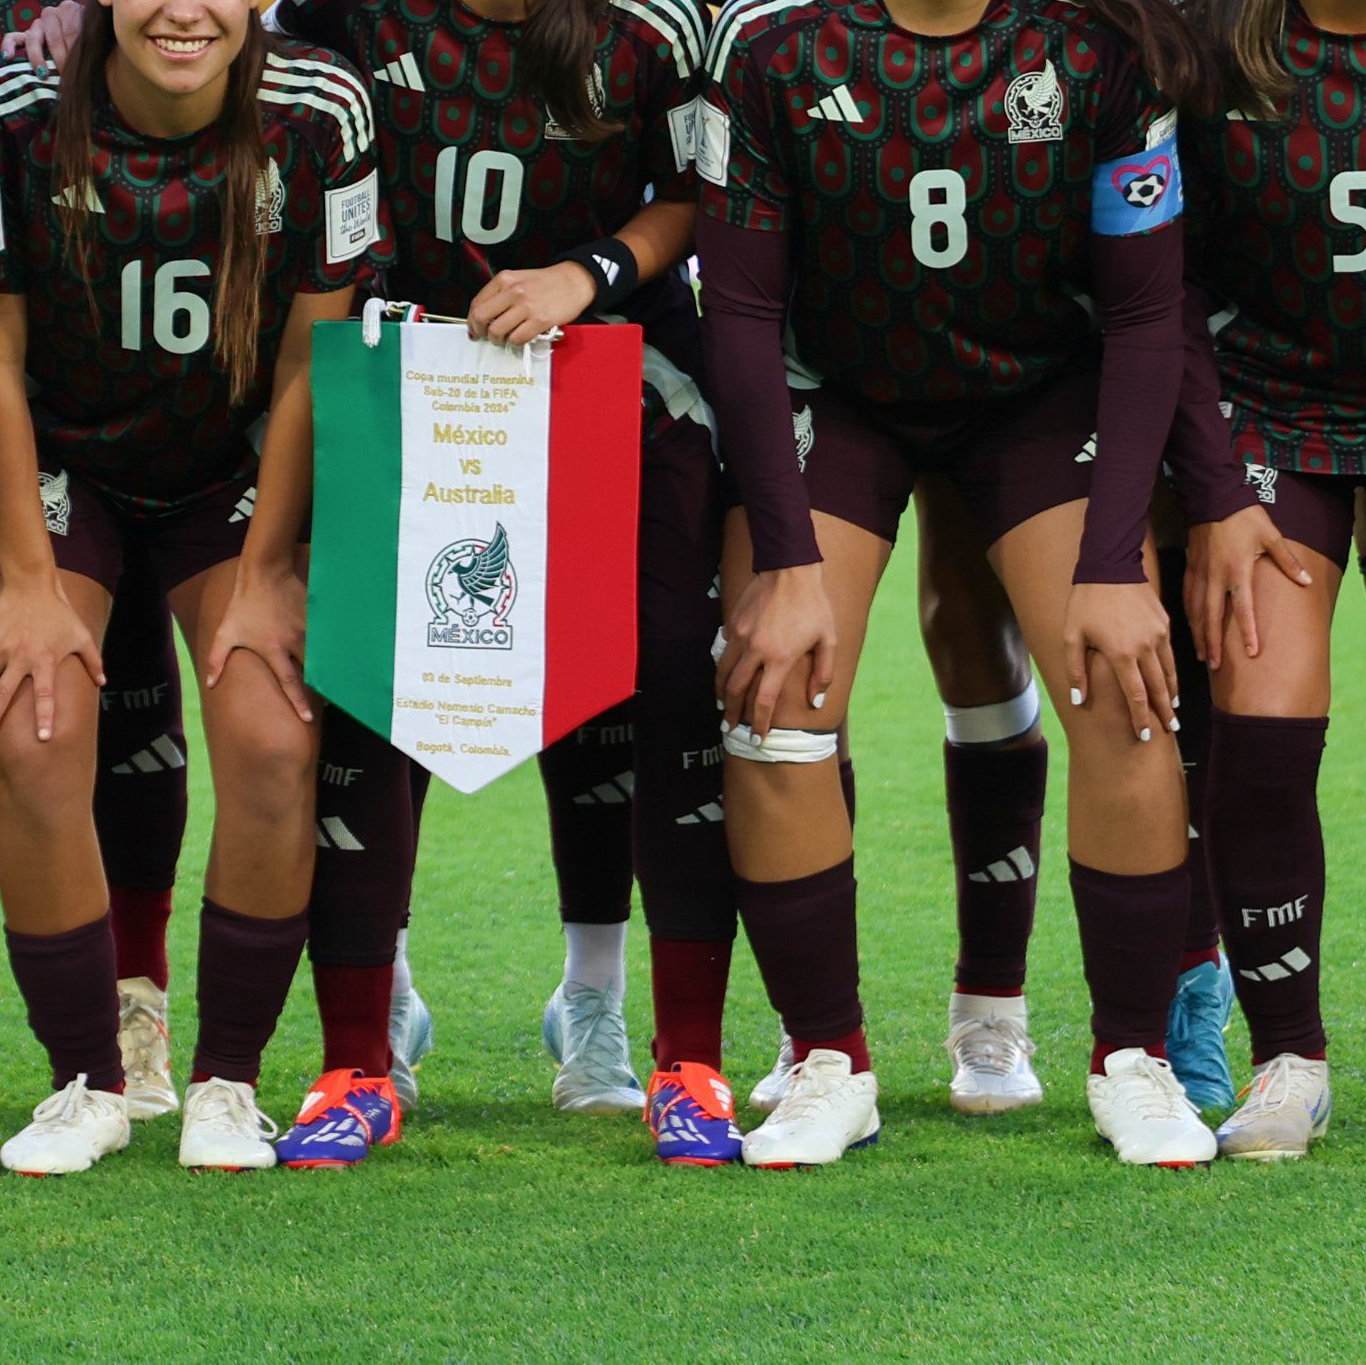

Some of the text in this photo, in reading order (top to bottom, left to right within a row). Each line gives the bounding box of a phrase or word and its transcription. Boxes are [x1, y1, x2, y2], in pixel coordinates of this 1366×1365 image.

[340, 189, 371, 210] FOOTBALL
[434, 146, 525, 246] 10
[341, 197, 371, 223] UNITES
[908, 169, 970, 269] 8
[121, 259, 212, 355] 16
[406, 370, 434, 383] Copa
[437, 373, 479, 384] mundial
[423, 385, 519, 399] Sub-20 de la FIFA
[431, 400, 481, 413] Colombia
[433, 421, 508, 446] México
[459, 457, 482, 475] vs
[423, 481, 516, 505] Australia
[431, 623, 509, 645] MÉXICO
[438, 673, 451, 684] de
[454, 673, 513, 687] Septiembre
[395, 698, 537, 717] Estadio Nemesio Camacho
[682, 743, 725, 770] FM
[319, 759, 364, 787] MF
[1241, 893, 1310, 929] FMF
